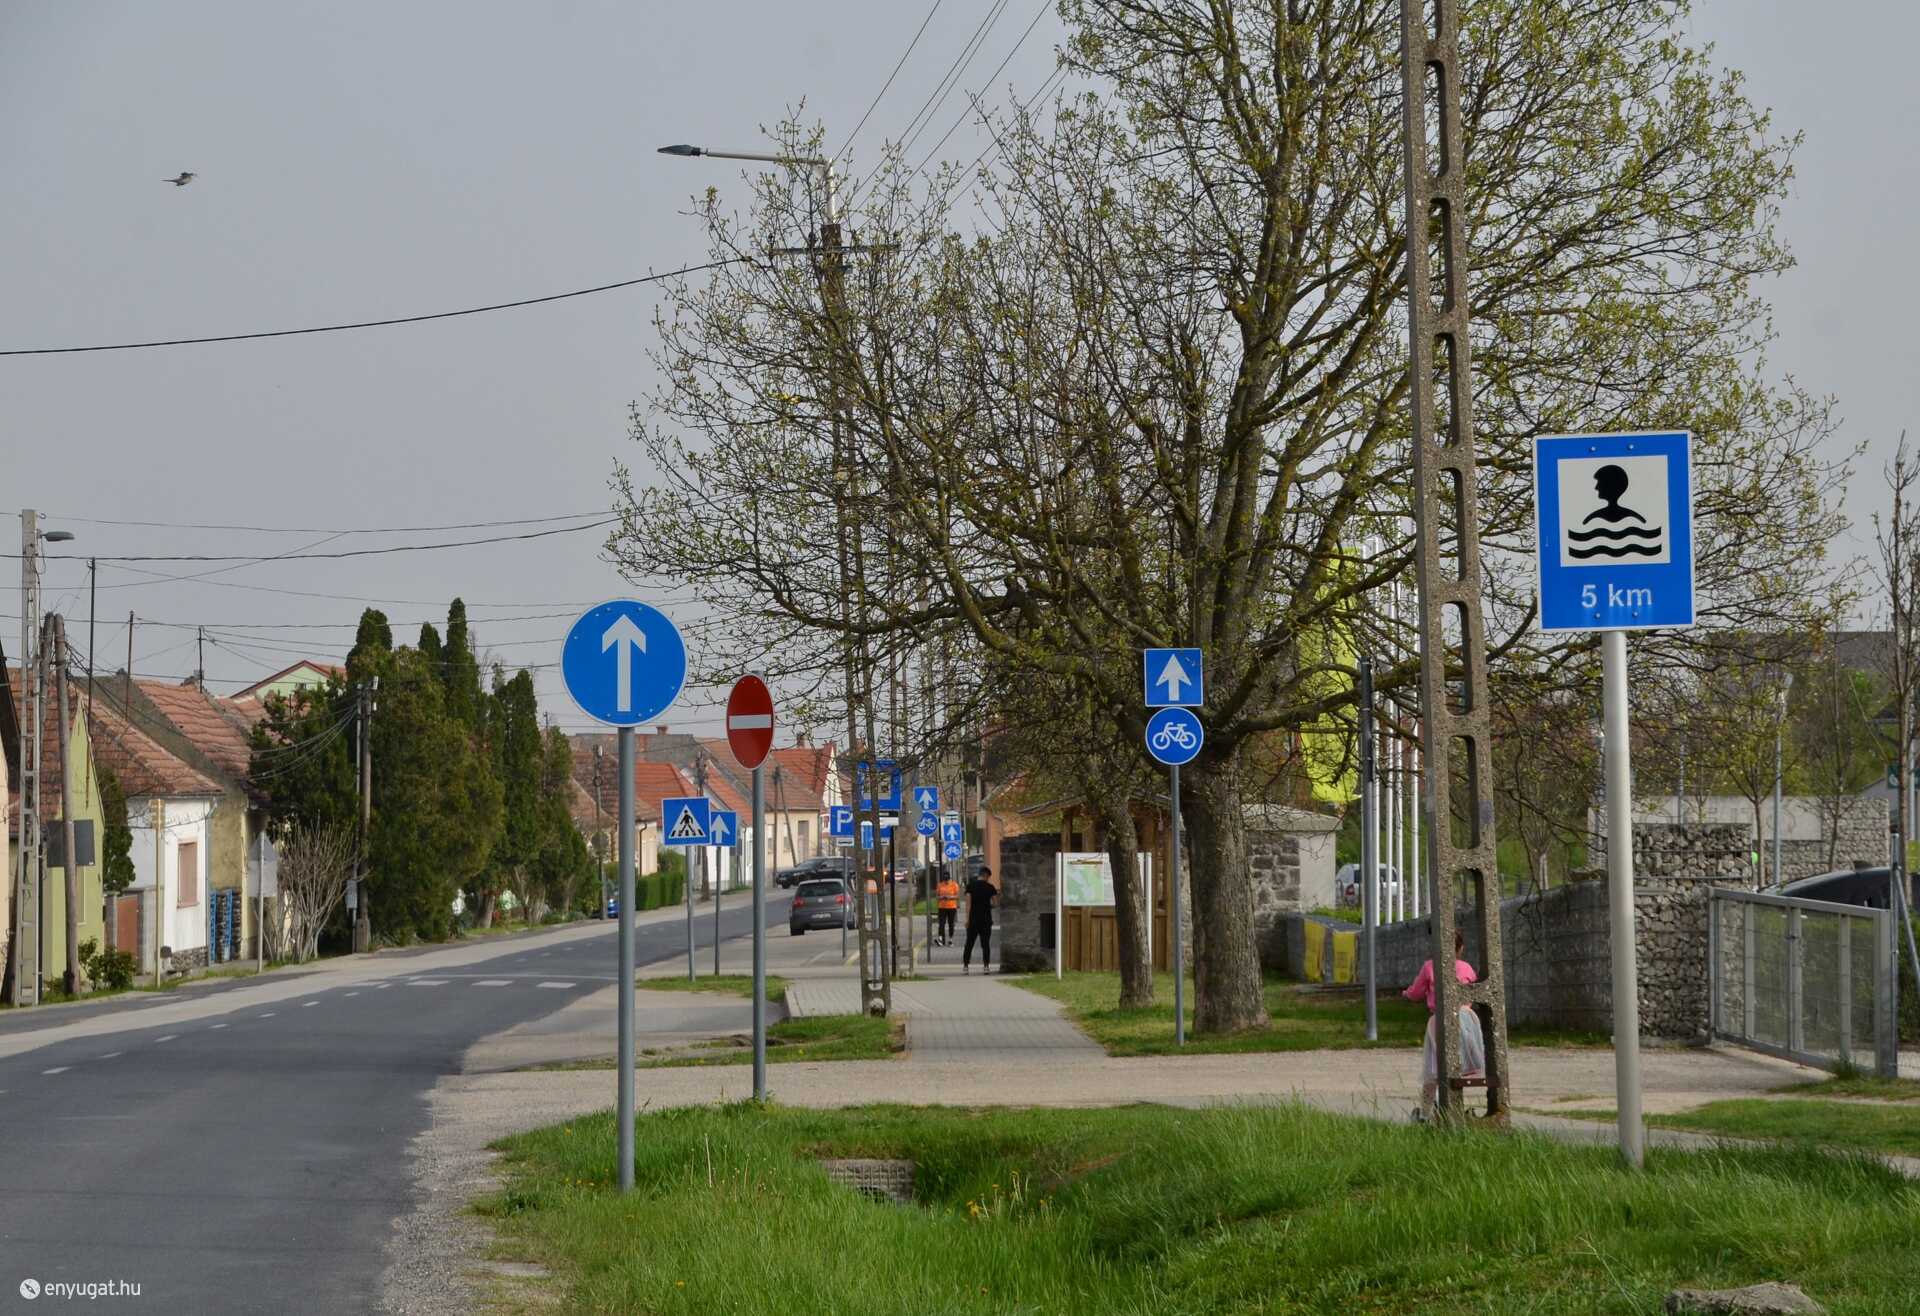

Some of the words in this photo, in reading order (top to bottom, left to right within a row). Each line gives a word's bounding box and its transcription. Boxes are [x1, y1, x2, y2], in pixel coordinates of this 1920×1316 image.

[1581, 584, 1598, 608] 5
[1608, 583, 1653, 607] km
[836, 809, 854, 833] P
